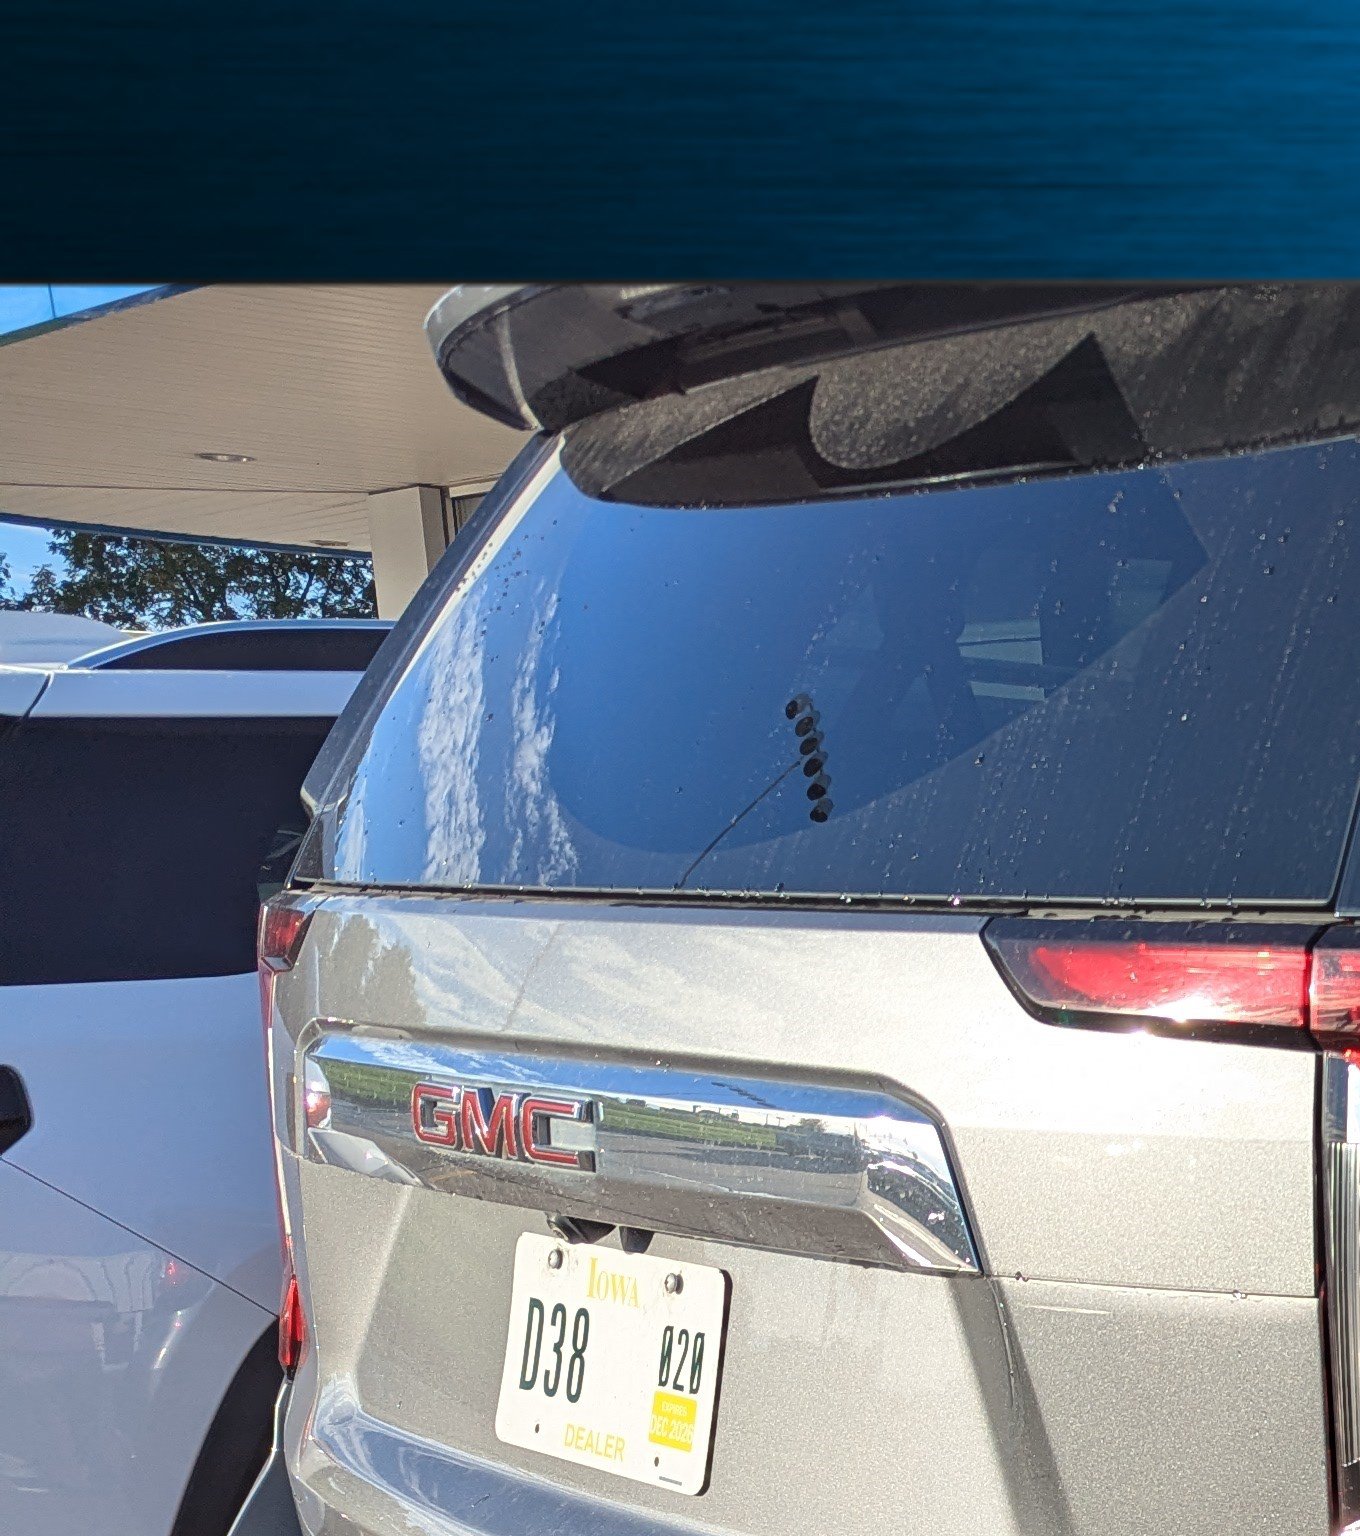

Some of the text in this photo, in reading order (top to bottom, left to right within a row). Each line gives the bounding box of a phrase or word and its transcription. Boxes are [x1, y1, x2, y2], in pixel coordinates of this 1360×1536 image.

[411, 1081, 588, 1170] GMC
[519, 1297, 590, 1403] D38
[564, 1423, 626, 1461] DEALER
